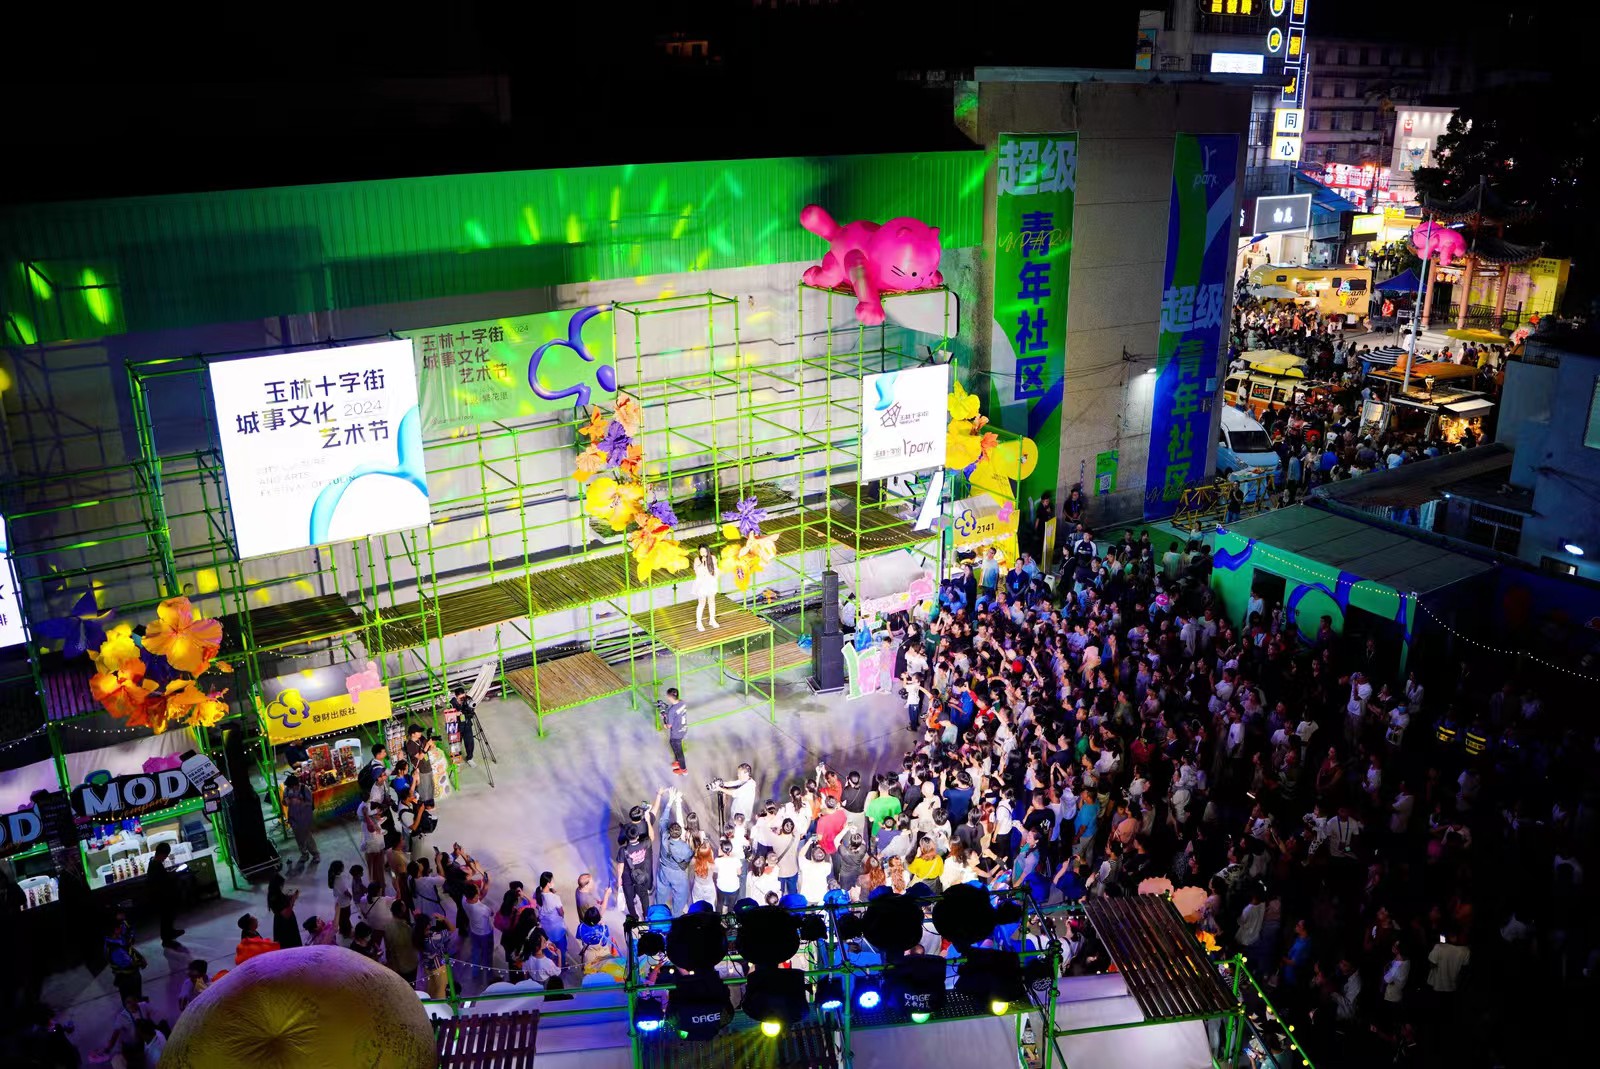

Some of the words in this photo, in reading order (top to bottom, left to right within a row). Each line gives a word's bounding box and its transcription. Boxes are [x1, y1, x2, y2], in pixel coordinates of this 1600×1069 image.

[1281, 112, 1298, 156] 同心
[998, 139, 1077, 196] 超级
[1014, 210, 1054, 401] 青年社区
[1160, 283, 1225, 334] 超级
[421, 326, 504, 352] 玉林十字街
[423, 347, 491, 369] 城事文化
[458, 363, 508, 384] 艺术节
[264, 368, 385, 405] 玉林十字街
[236, 401, 337, 435] 城事文化
[344, 400, 384, 417] 2024
[1163, 339, 1205, 502] 青年社区
[318, 420, 389, 449] 艺术节
[976, 522, 995, 534] 2141
[312, 706, 357, 723] 發財出版社
[82, 770, 189, 817] MOD
[904, 993, 930, 1001] DAGE
[691, 1012, 720, 1024] DAGE
